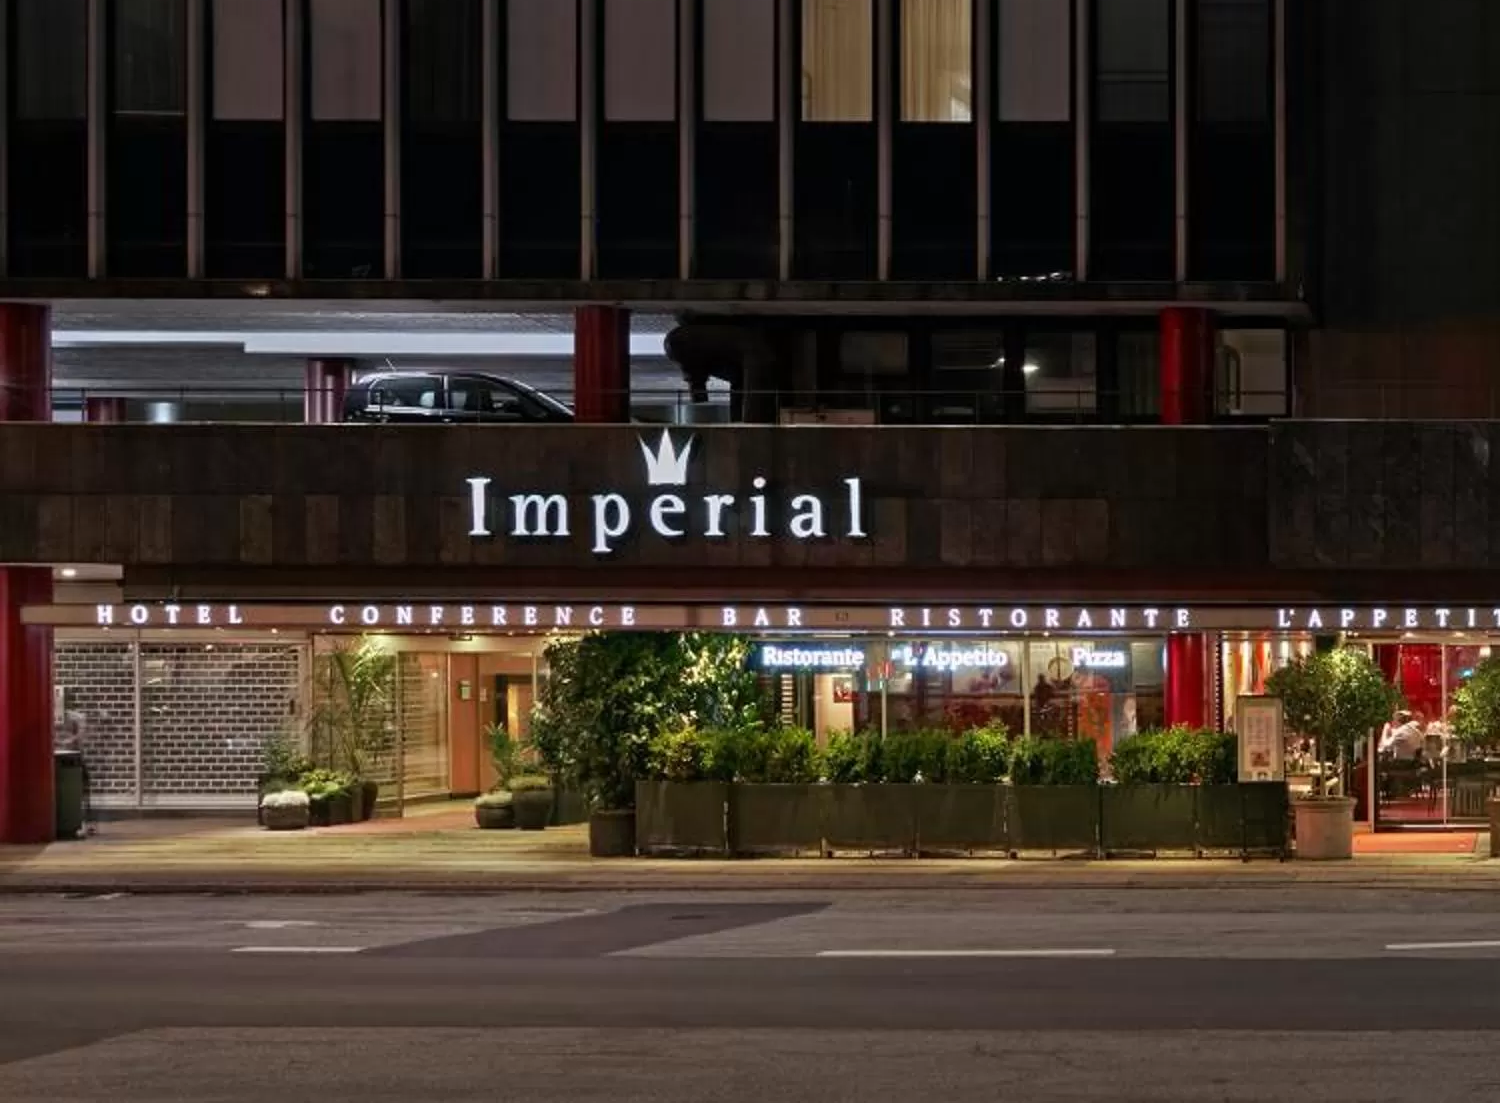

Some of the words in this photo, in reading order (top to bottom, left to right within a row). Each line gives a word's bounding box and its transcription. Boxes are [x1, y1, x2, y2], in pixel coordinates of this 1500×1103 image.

[467, 476, 866, 552] Imperial
[97, 605, 242, 624] HOTEL
[330, 606, 636, 625] CONFERENCE
[723, 608, 802, 626] BAR
[891, 608, 1189, 627] RISTORANTE
[763, 646, 865, 667] Ristorante
[1071, 647, 1125, 667] Pizza
